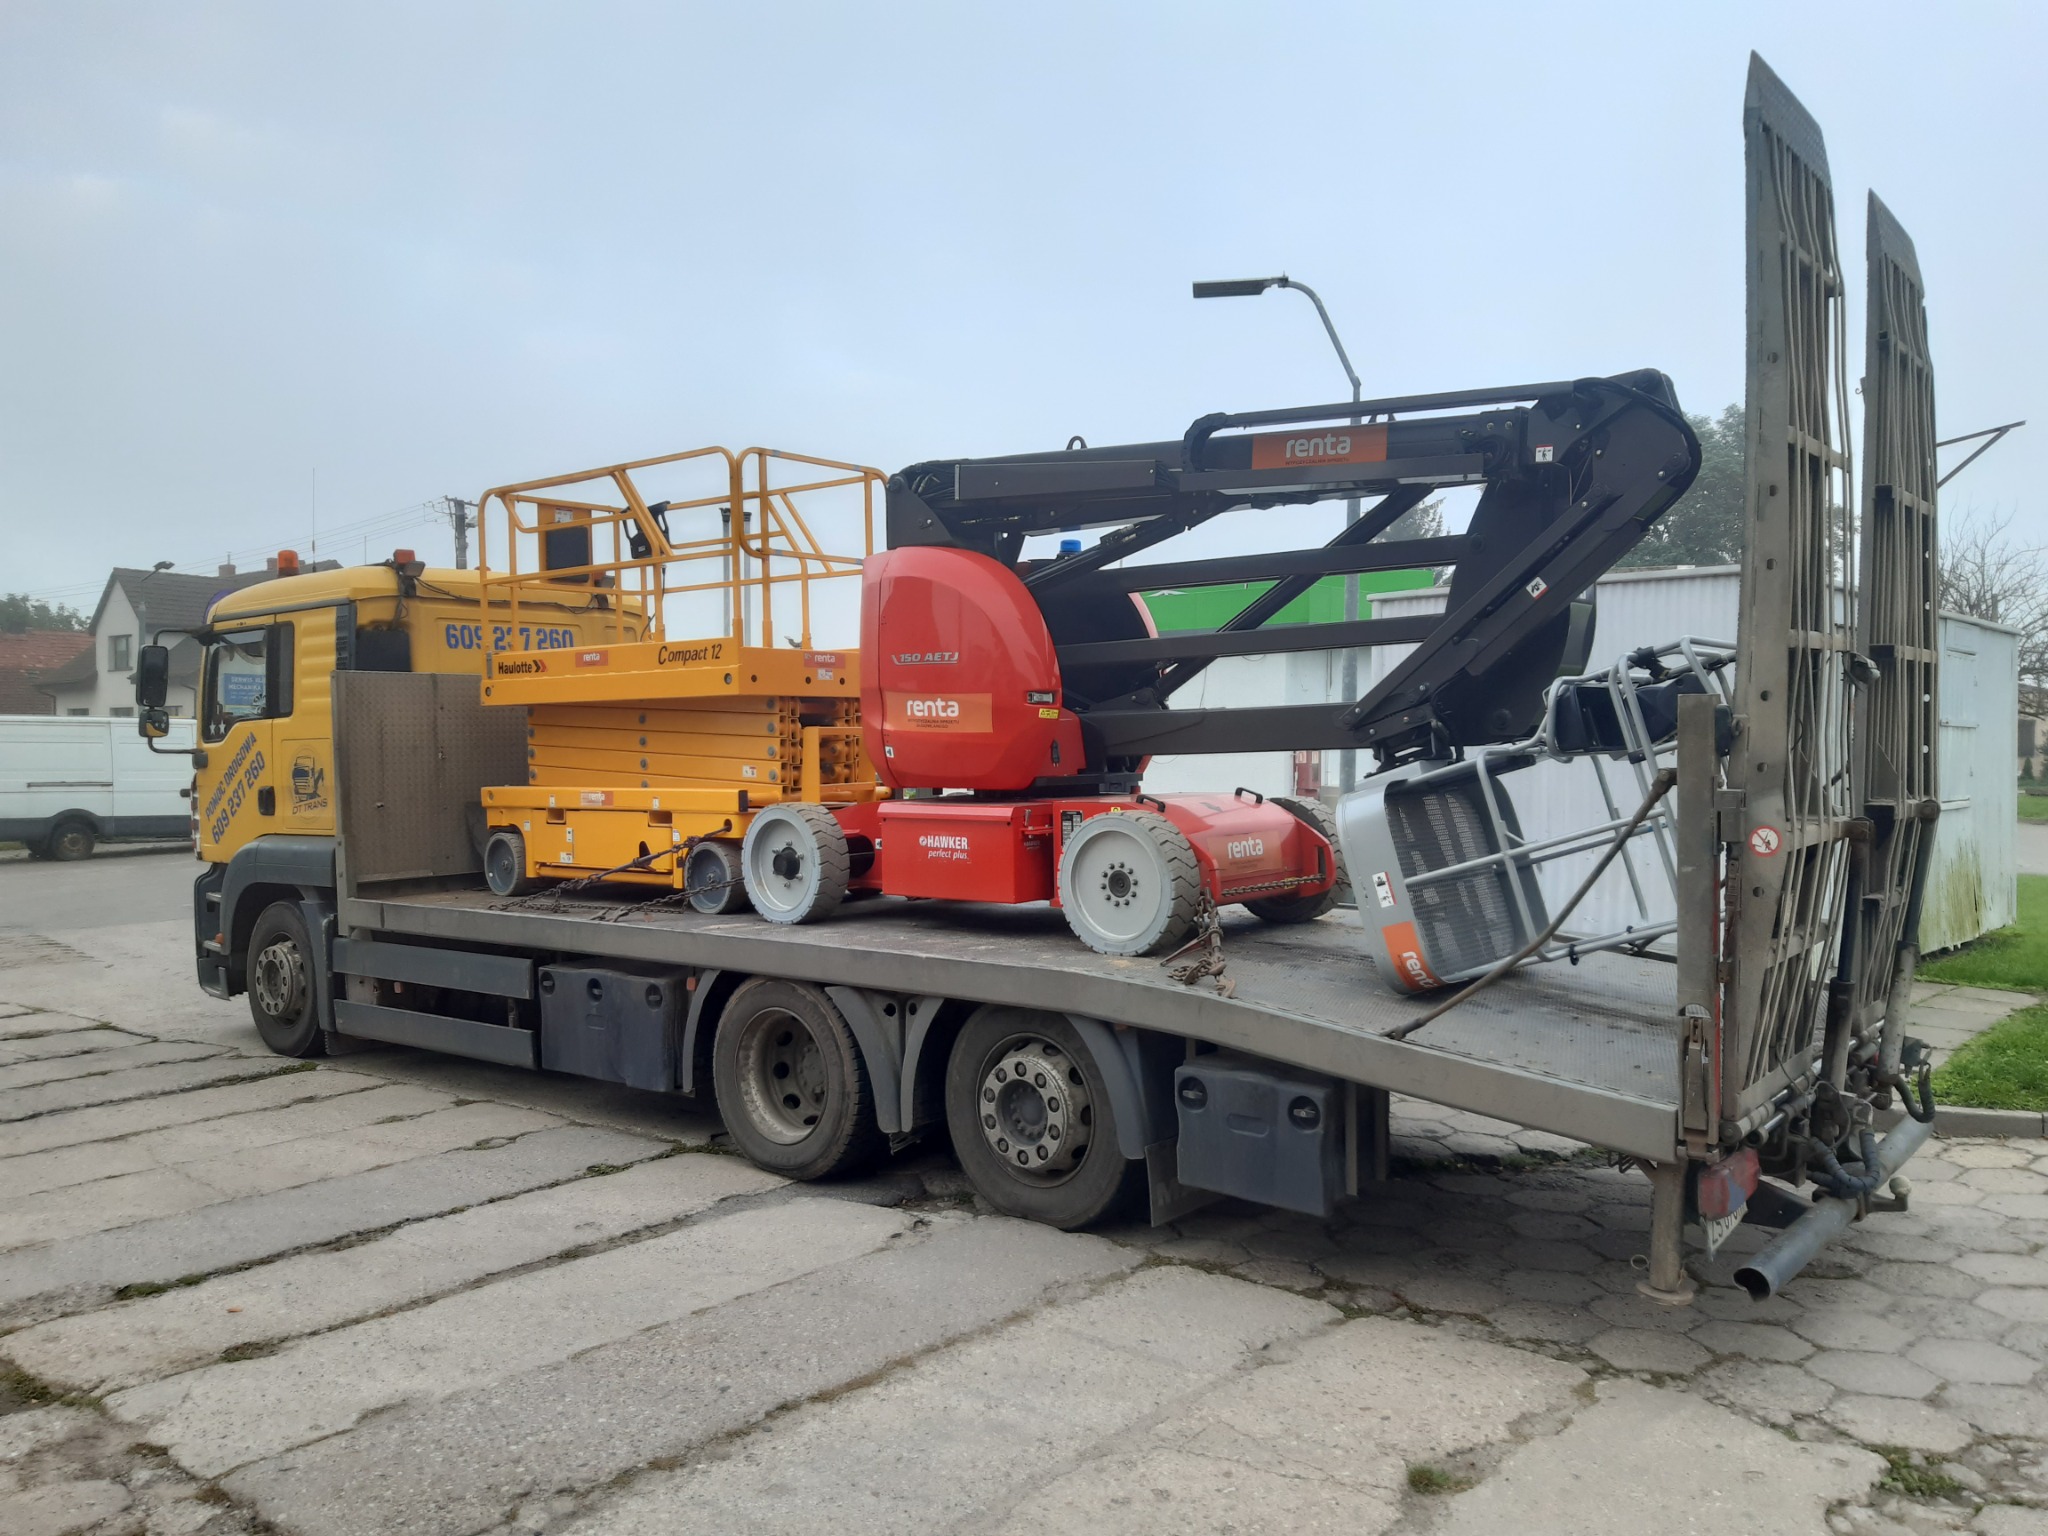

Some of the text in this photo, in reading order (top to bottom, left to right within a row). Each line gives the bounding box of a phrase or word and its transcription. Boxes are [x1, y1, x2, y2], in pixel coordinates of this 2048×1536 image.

[1285, 433, 1351, 458] renta
[536, 628, 574, 649] 260
[583, 652, 600, 661] renta
[657, 643, 722, 666] Compact 12
[814, 653, 836, 663] renta
[899, 652, 960, 663] 150 AETJ
[498, 661, 533, 674] Haulotte
[906, 698, 960, 717] renta
[205, 781, 226, 821] POMOC
[223, 731, 257, 787] DROGOWA
[211, 750, 265, 844] 609 237 260
[292, 798, 328, 815] DT TRANS
[927, 835, 968, 850] HAWKER
[1227, 836, 1264, 859] renta
[928, 849, 968, 860] perfect plus
[1402, 951, 1439, 988] rent
